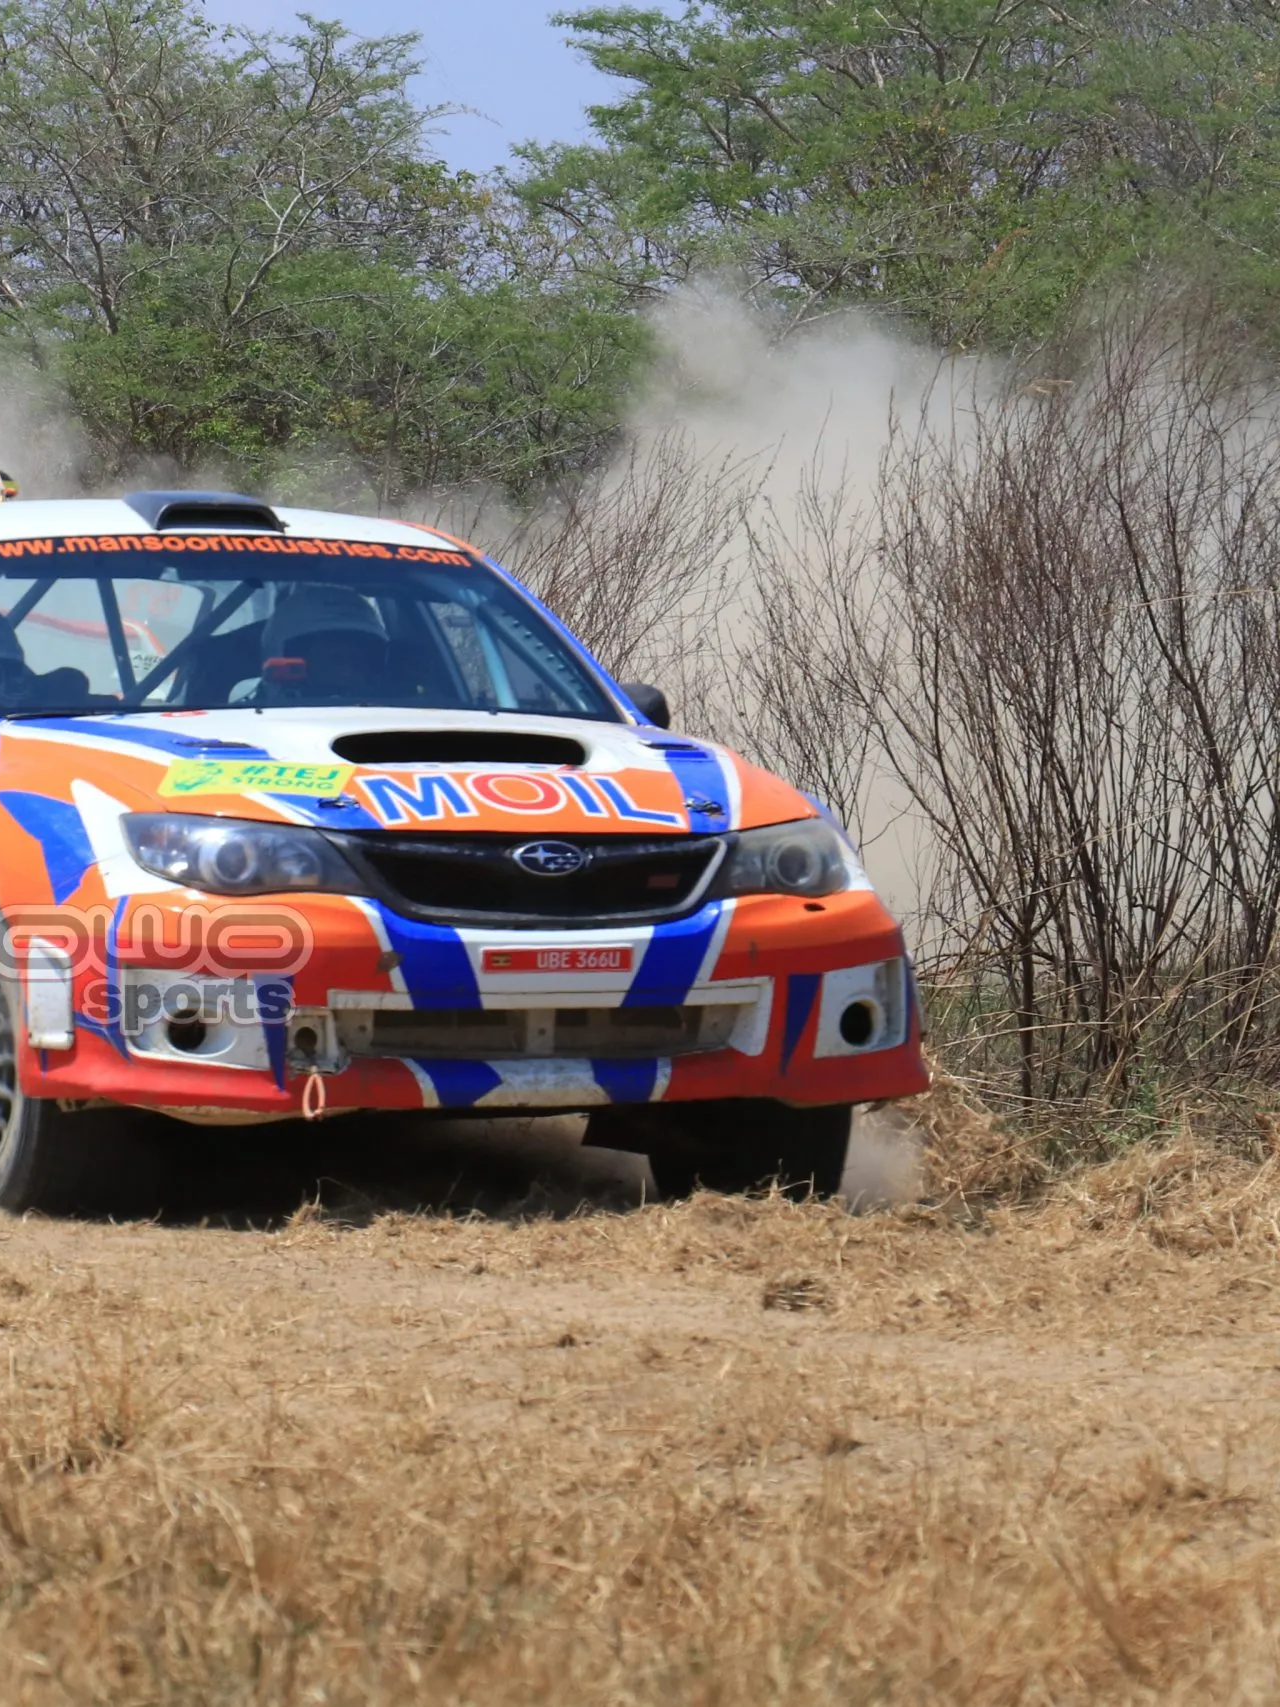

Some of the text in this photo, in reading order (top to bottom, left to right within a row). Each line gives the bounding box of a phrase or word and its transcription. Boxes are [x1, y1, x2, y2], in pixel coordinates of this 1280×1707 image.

[242, 765, 341, 781] #TEJ
[231, 775, 334, 791] STRONG
[354, 771, 688, 829] MOIL
[536, 951, 620, 969] UBE 366U
